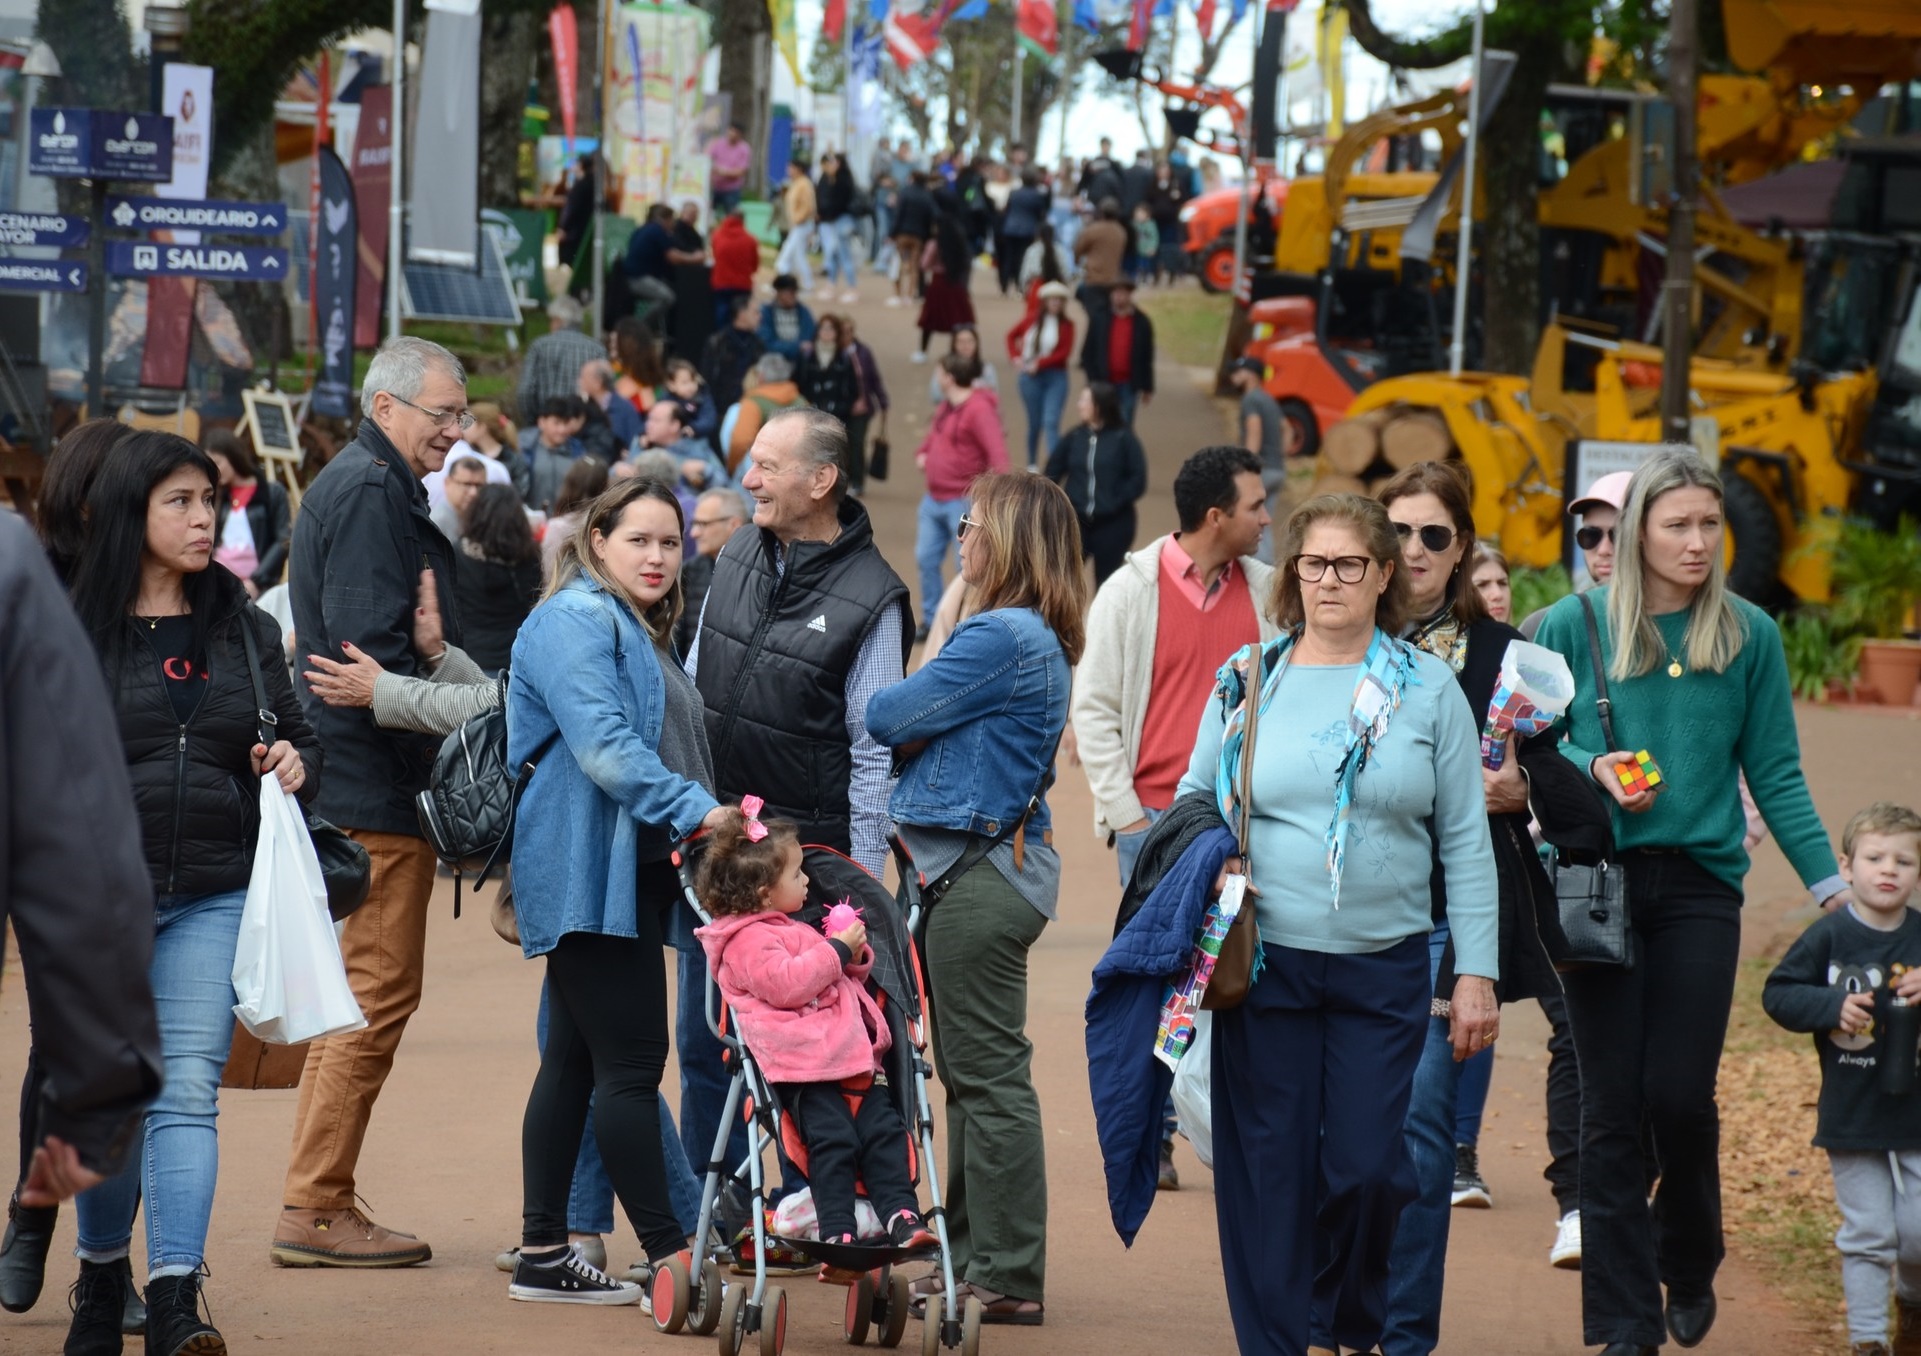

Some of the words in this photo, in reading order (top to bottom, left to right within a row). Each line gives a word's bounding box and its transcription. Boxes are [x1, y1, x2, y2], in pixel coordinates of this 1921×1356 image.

[140, 206, 259, 229] ORQUIDEARIO
[167, 248, 249, 273] SALIDA
[0, 265, 63, 283] MERCIAL
[807, 622, 826, 633] adidas
[1838, 1053, 1876, 1068] Always
[314, 1217, 333, 1230] CAT
